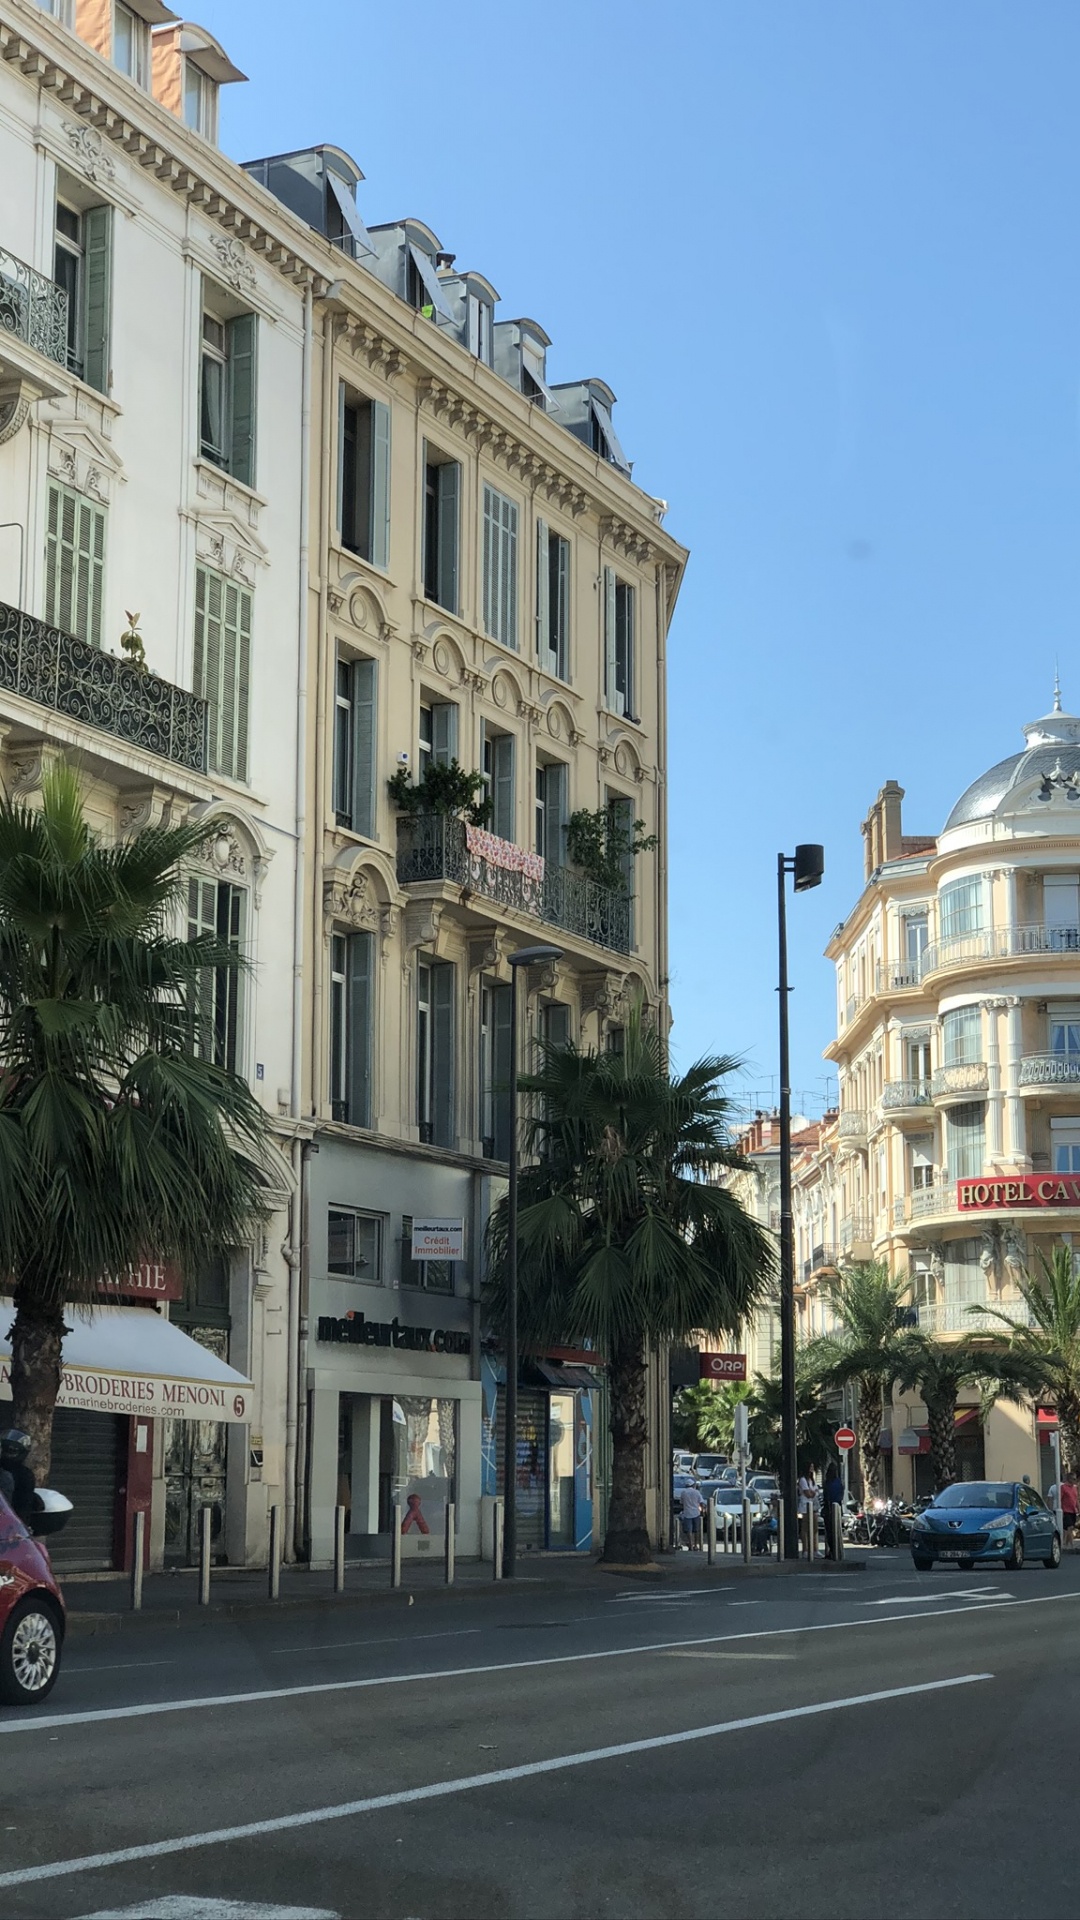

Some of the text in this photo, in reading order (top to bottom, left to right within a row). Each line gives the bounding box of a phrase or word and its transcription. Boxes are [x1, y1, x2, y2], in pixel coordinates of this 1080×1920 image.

[960, 1181, 1032, 1205] HOTEL
[415, 1246, 460, 1255] Immobilier
[424, 1236, 450, 1245] Crédit
[317, 1310, 471, 1355] meilleurtaux.com
[711, 1357, 745, 1372] ORPI
[63, 1372, 155, 1401] BRODERIES
[162, 1383, 226, 1407] MENONI
[56, 1395, 185, 1416] w.marinebroderies.com
